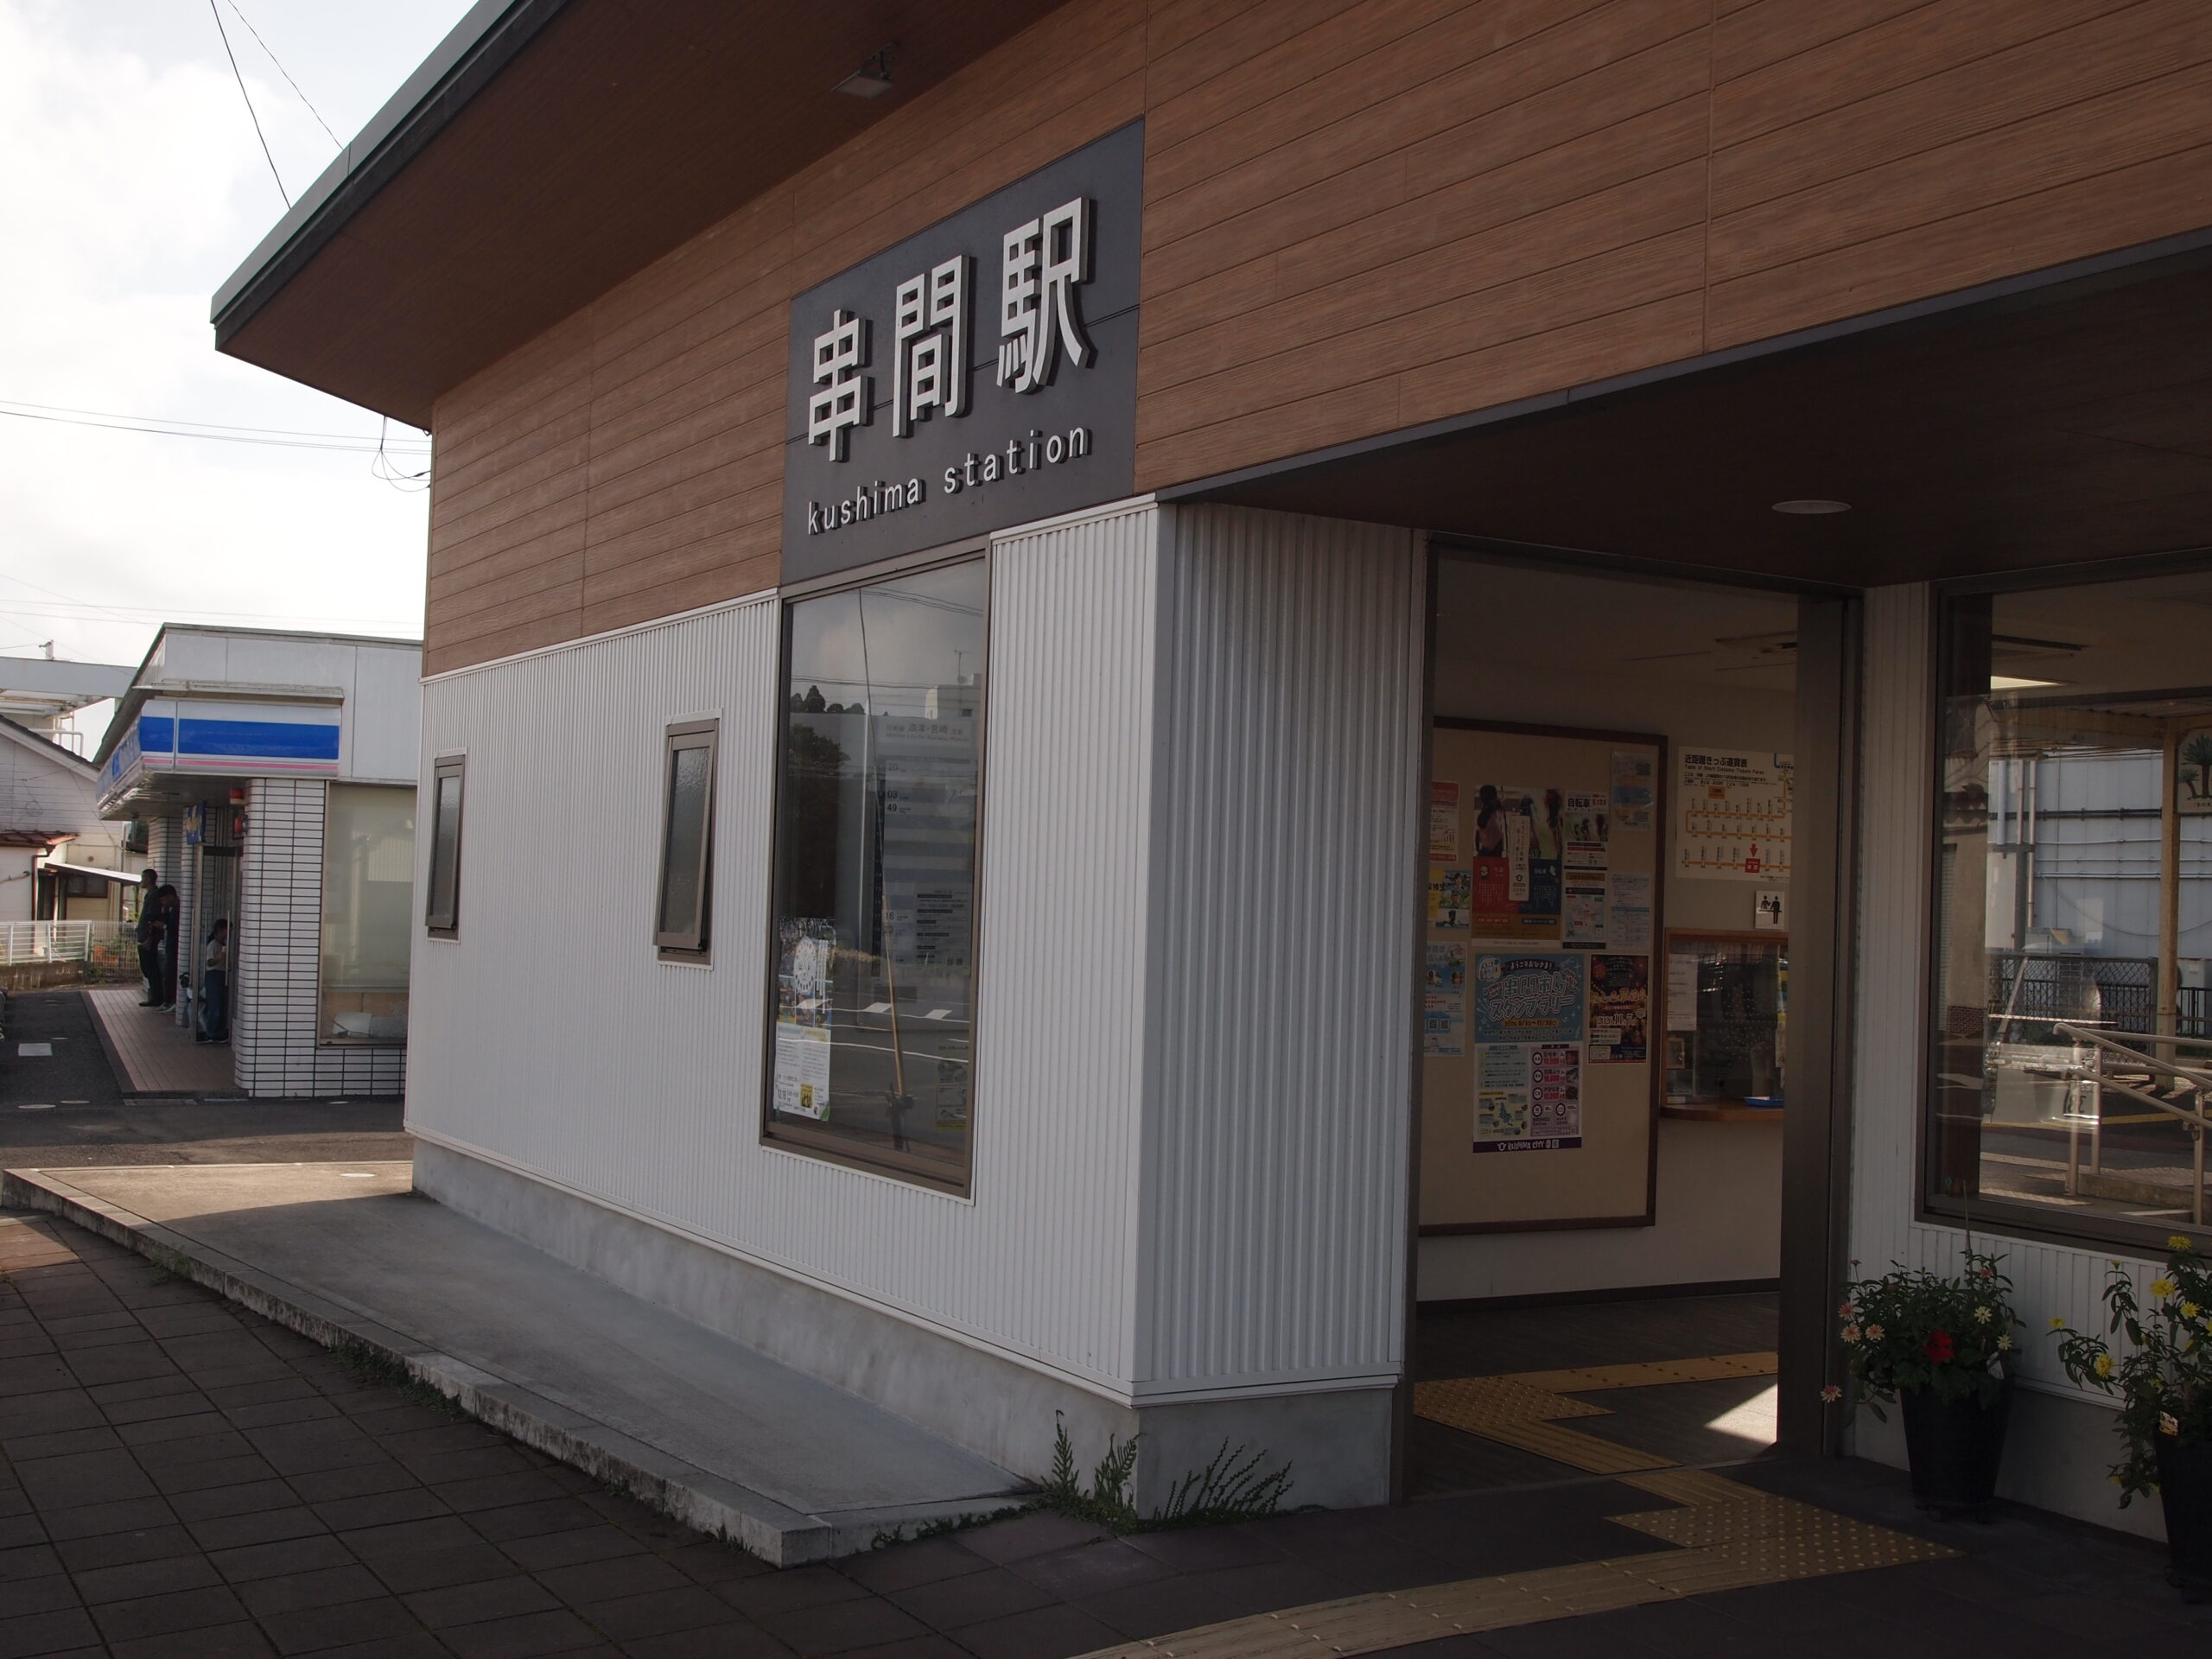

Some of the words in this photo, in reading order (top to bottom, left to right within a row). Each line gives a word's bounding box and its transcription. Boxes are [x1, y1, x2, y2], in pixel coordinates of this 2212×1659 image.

[809, 197, 1089, 462] 串間駅
[809, 479, 924, 534] kushima
[944, 427, 1087, 493] station
[887, 790, 898, 799] 03
[1568, 798, 1590, 807] 自転車
[887, 804, 897, 812] 49
[1489, 994, 1574, 1020] スタンプラリー
